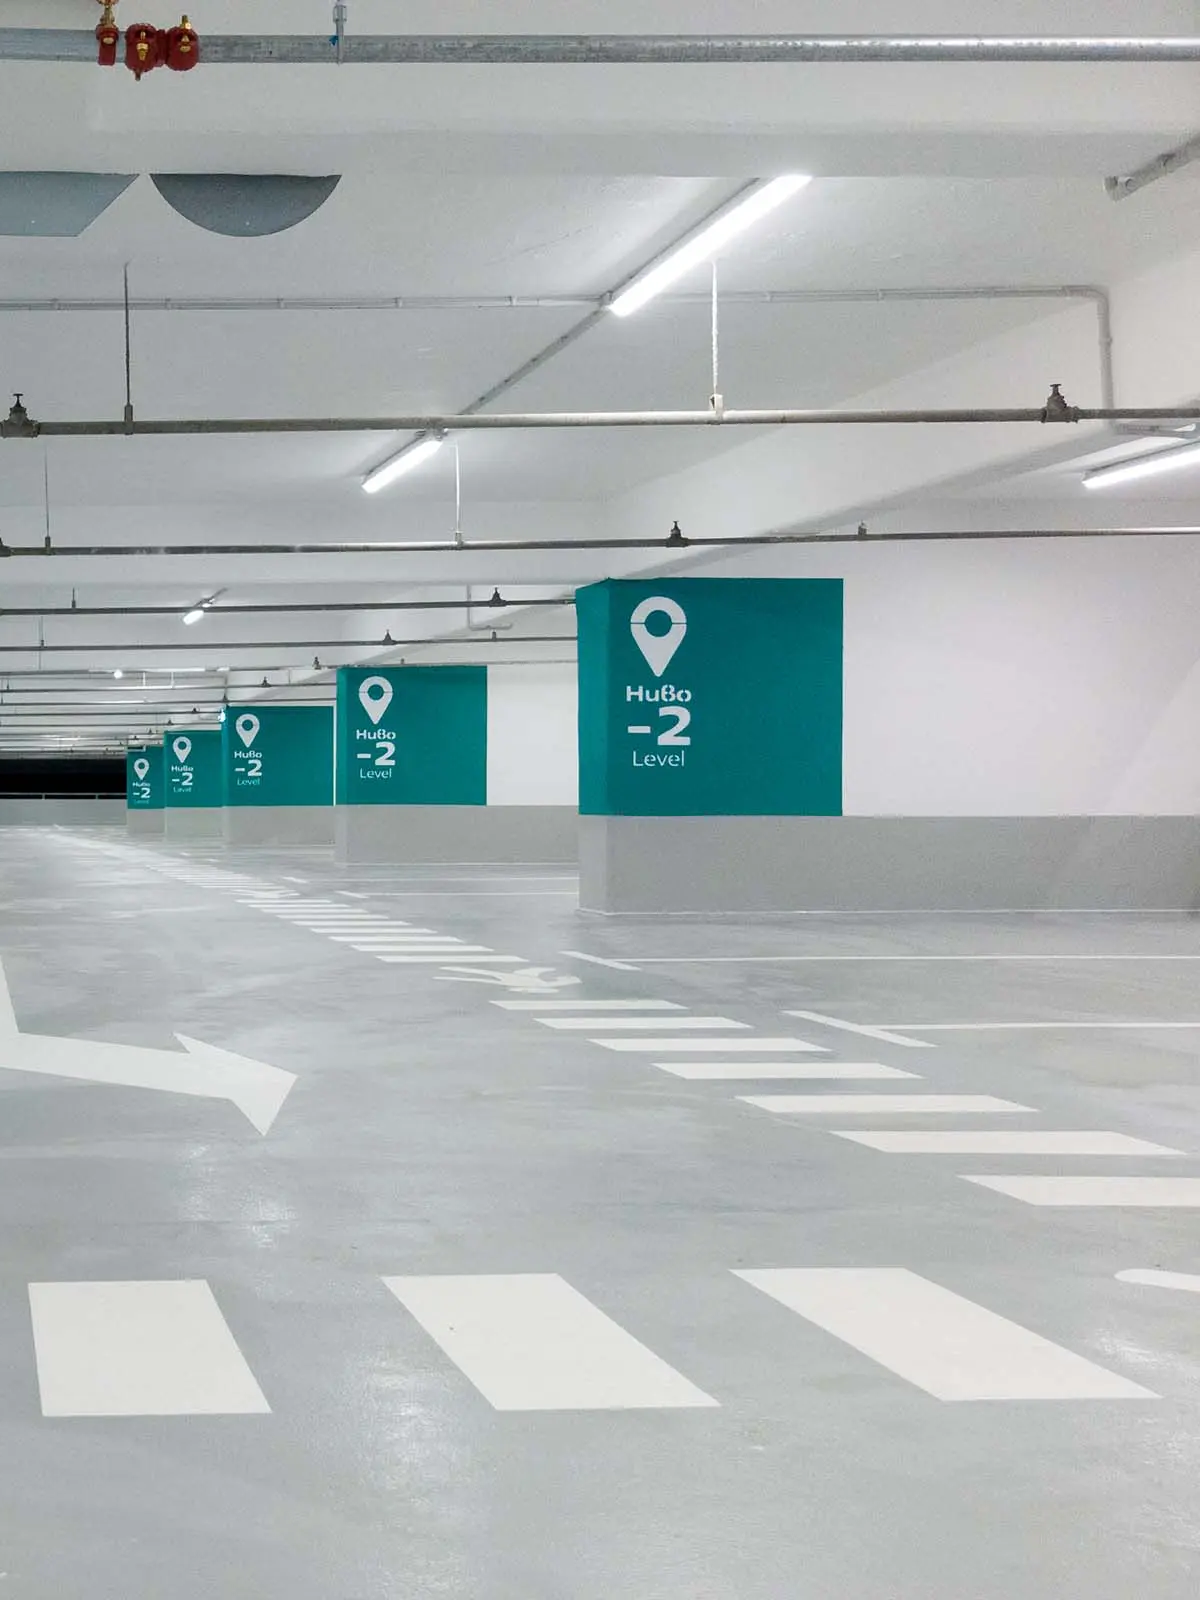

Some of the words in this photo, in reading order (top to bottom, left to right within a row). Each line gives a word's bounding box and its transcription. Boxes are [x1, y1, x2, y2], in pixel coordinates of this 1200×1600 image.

[627, 706, 691, 746] -2
[356, 742, 396, 766] -2
[633, 750, 685, 767] Level
[235, 760, 263, 777] -2
[360, 768, 392, 779] Level
[172, 773, 194, 786] -2
[237, 778, 261, 786] Level
[133, 788, 151, 799] -2
